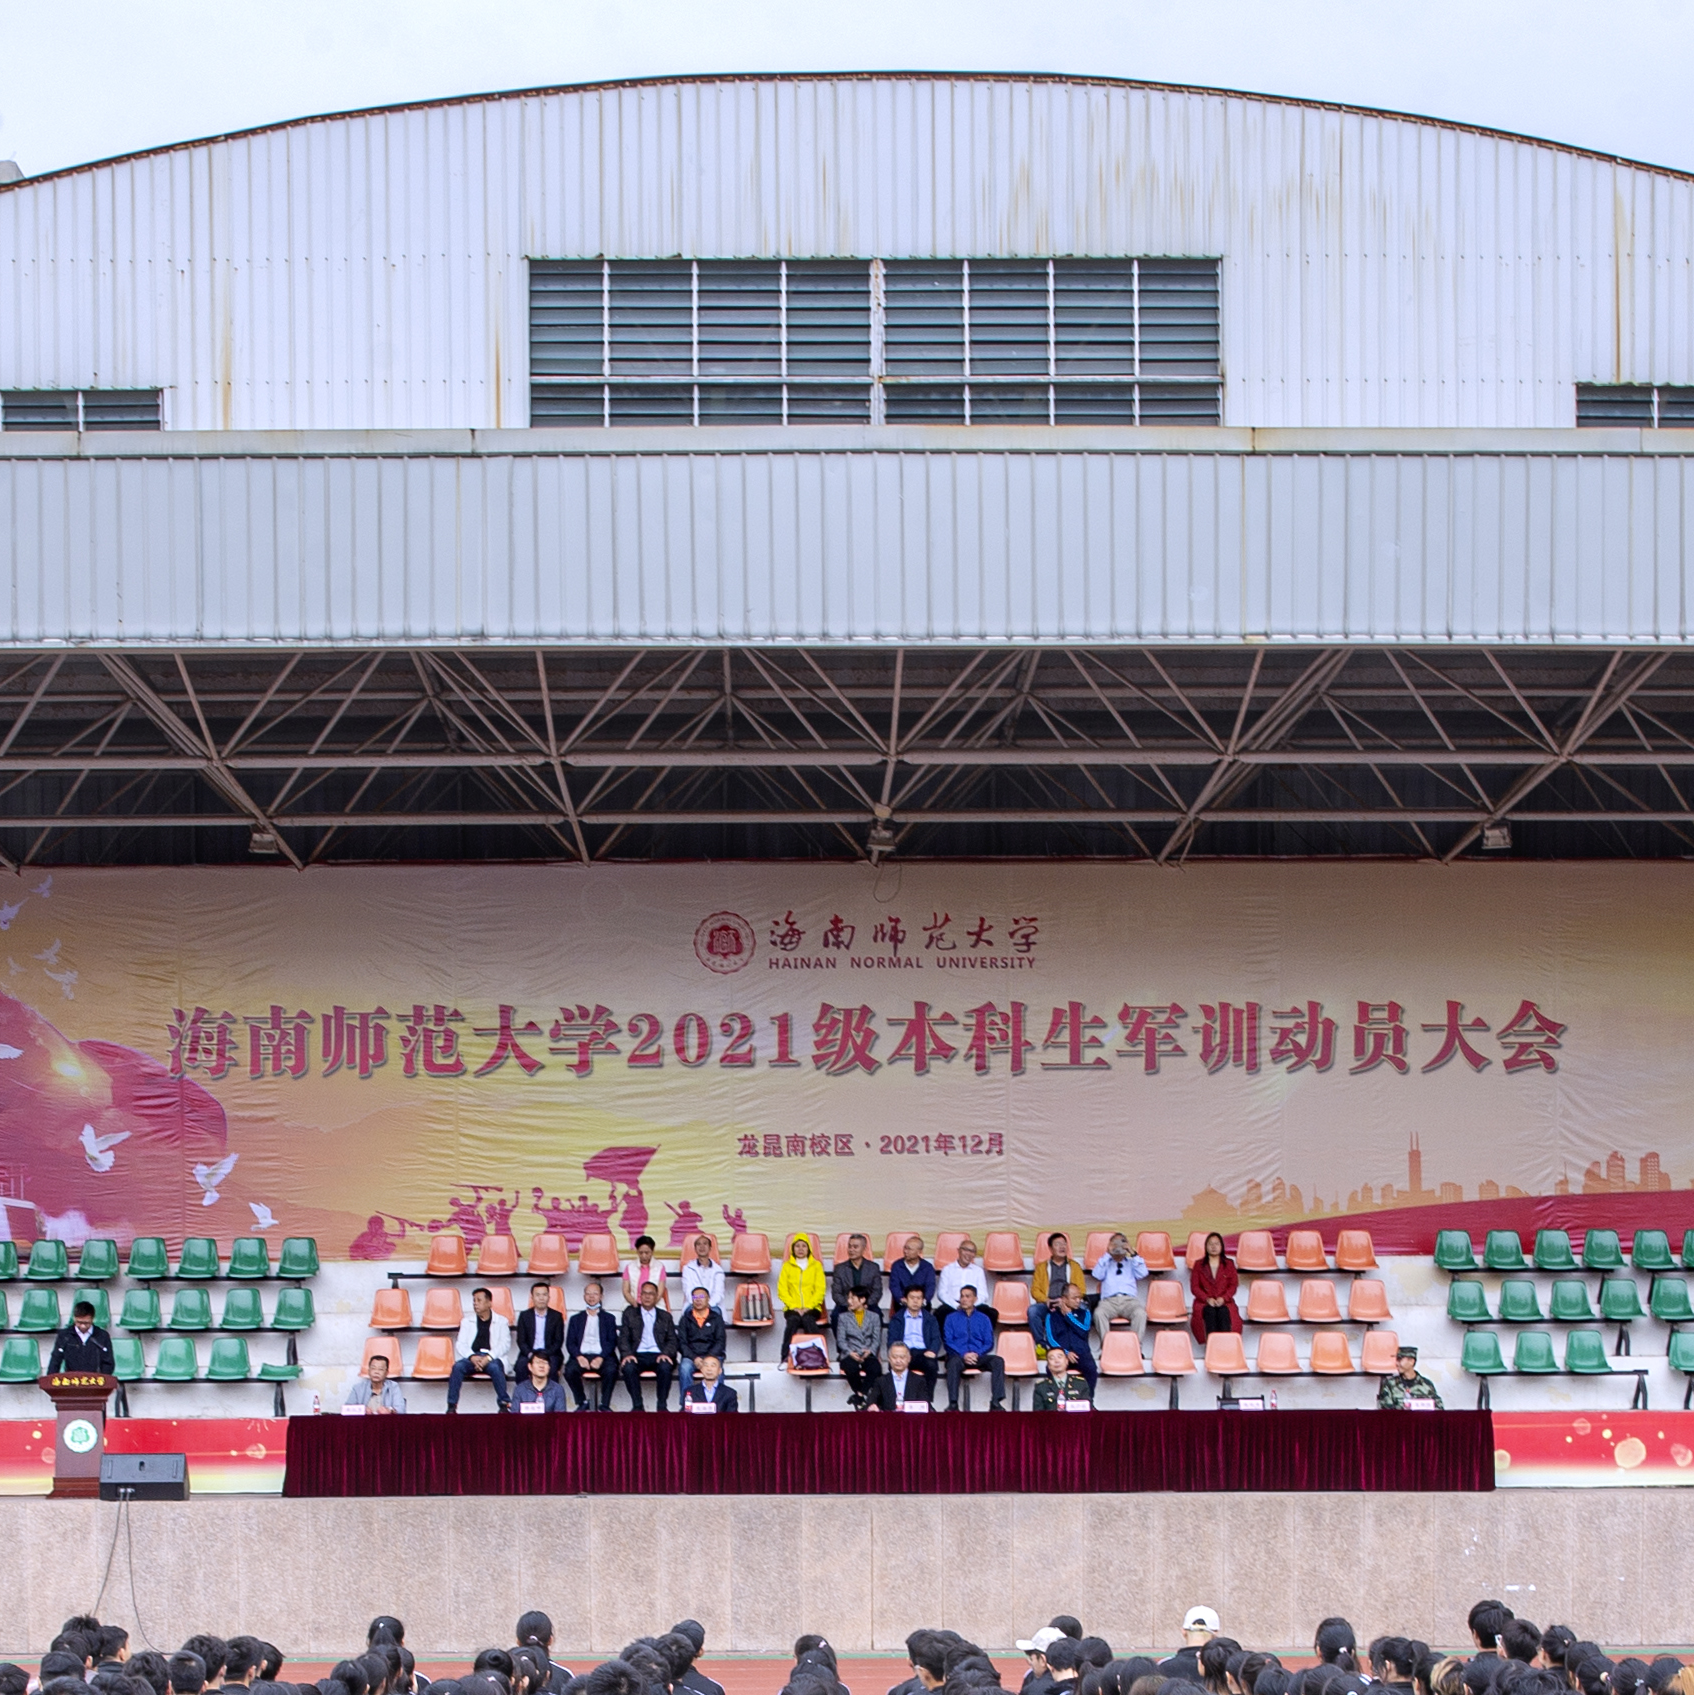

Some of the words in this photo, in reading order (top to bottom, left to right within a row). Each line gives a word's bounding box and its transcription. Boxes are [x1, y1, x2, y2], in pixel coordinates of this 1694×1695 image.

[769, 910, 1039, 956] 海南师范大学
[768, 957, 837, 969] HAINAN
[850, 957, 924, 969] NORMAL
[936, 956, 1036, 969] UNIVERSITY
[166, 1000, 1567, 1079] 海南师范大学2021级本科生军训动员大会
